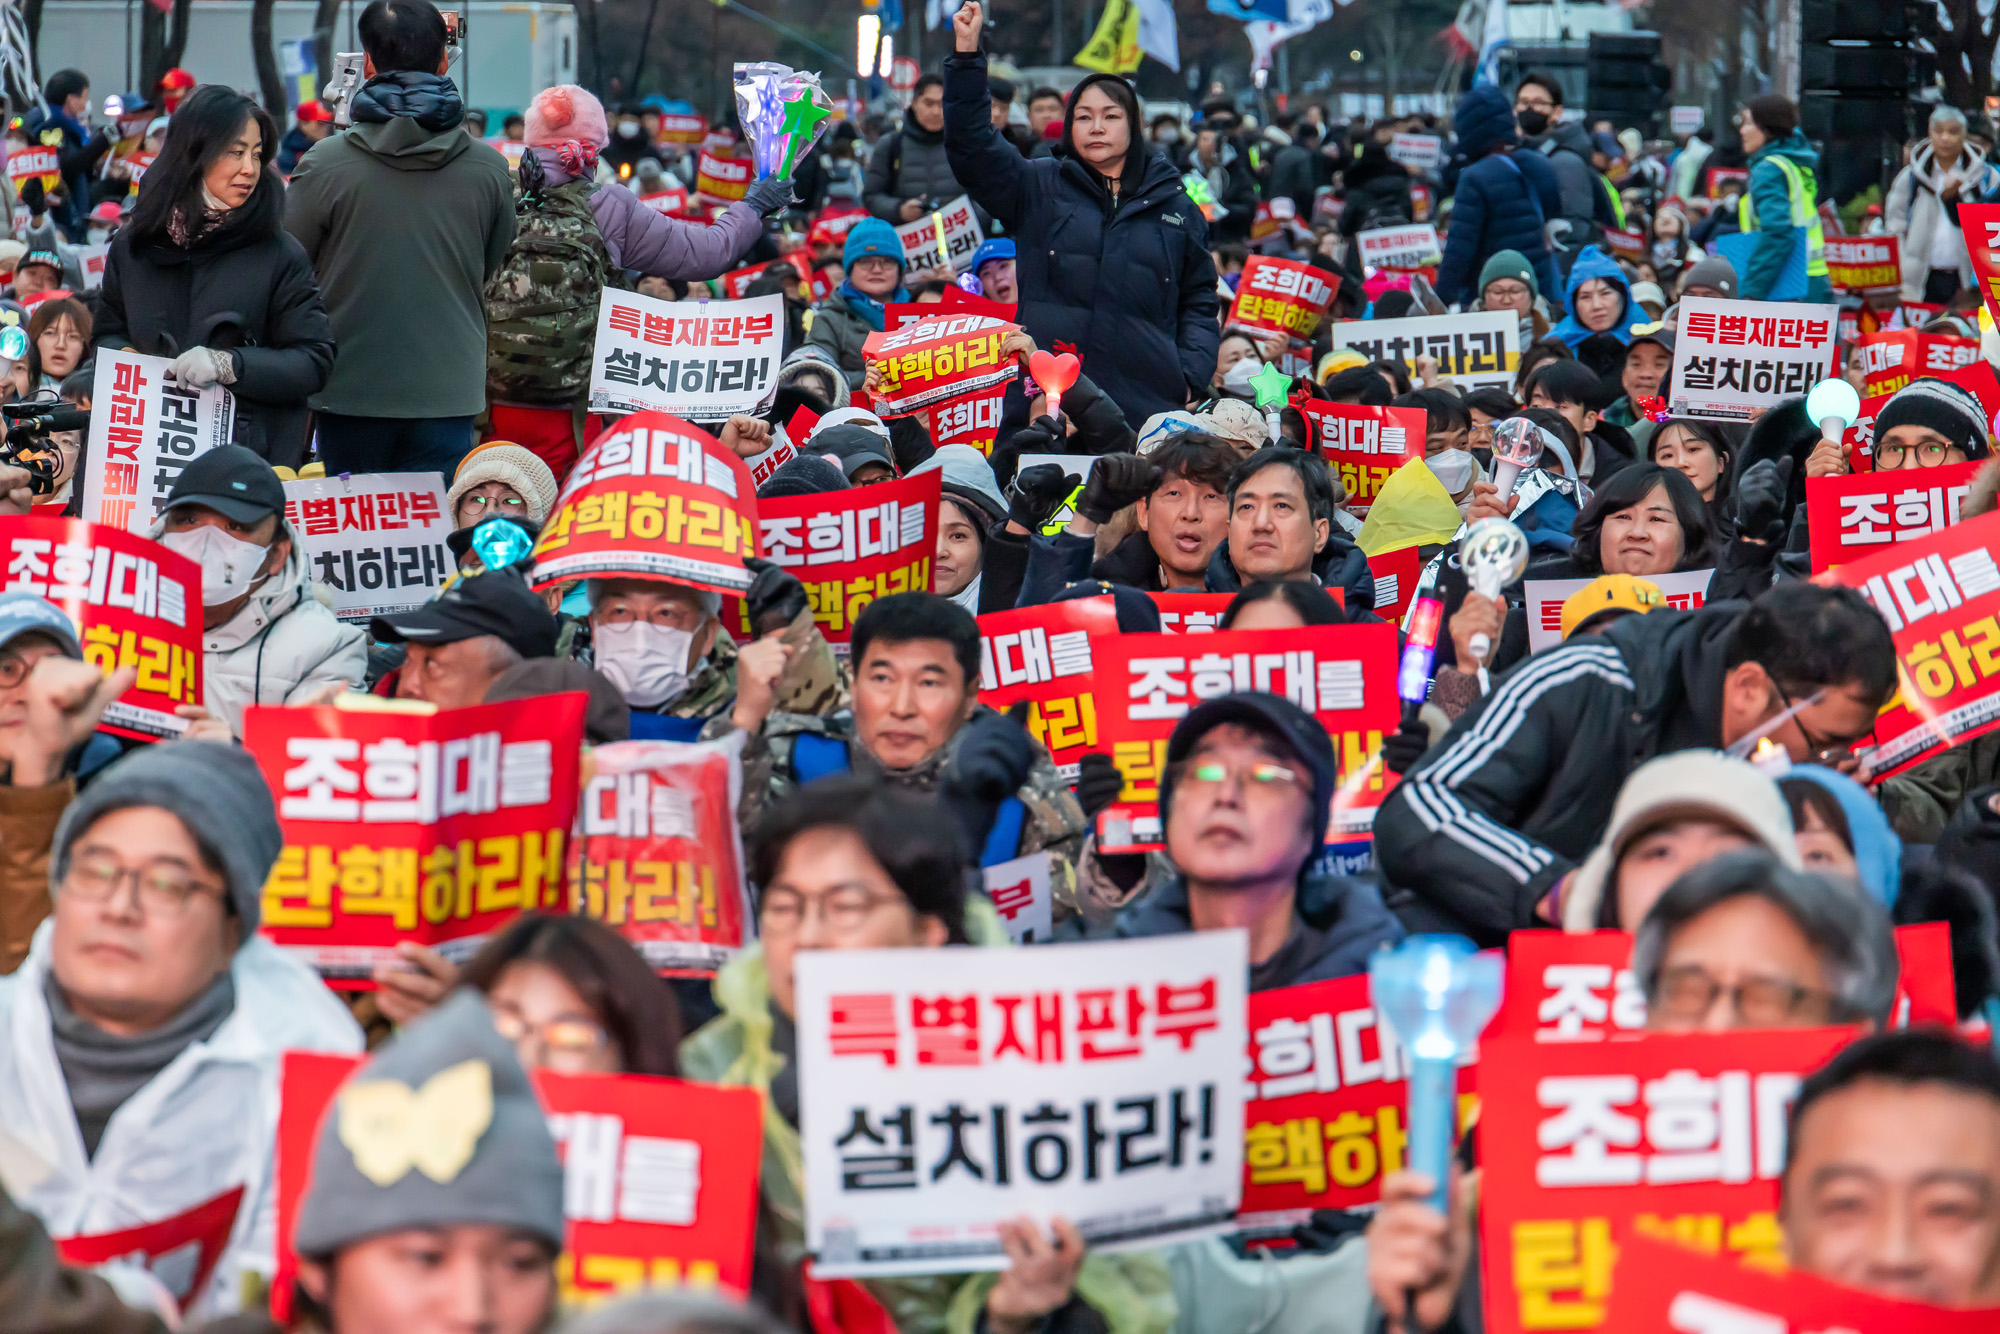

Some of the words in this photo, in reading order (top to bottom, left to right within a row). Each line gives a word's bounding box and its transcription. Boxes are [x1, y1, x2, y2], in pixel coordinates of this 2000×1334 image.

[1251, 264, 1332, 306] 조희대를
[609, 304, 773, 346] 특별재판부
[879, 315, 1007, 353] 조희대를
[1687, 312, 1829, 349] 특별재판부
[604, 347, 769, 394] 설치하라!
[558, 428, 738, 500] 조희대를
[1306, 411, 1406, 454] 희대를
[760, 500, 925, 567] 조희대를
[1840, 484, 1970, 546] 조희
[5, 538, 186, 628] 조희대를
[307, 543, 447, 592] 치하라!
[1128, 650, 1364, 720] 조희대를
[281, 732, 552, 824] 조희대를
[261, 829, 564, 929] 탄핵하라!
[829, 976, 1218, 1068] 특별재판부
[835, 1083, 1215, 1191] 설치하라!
